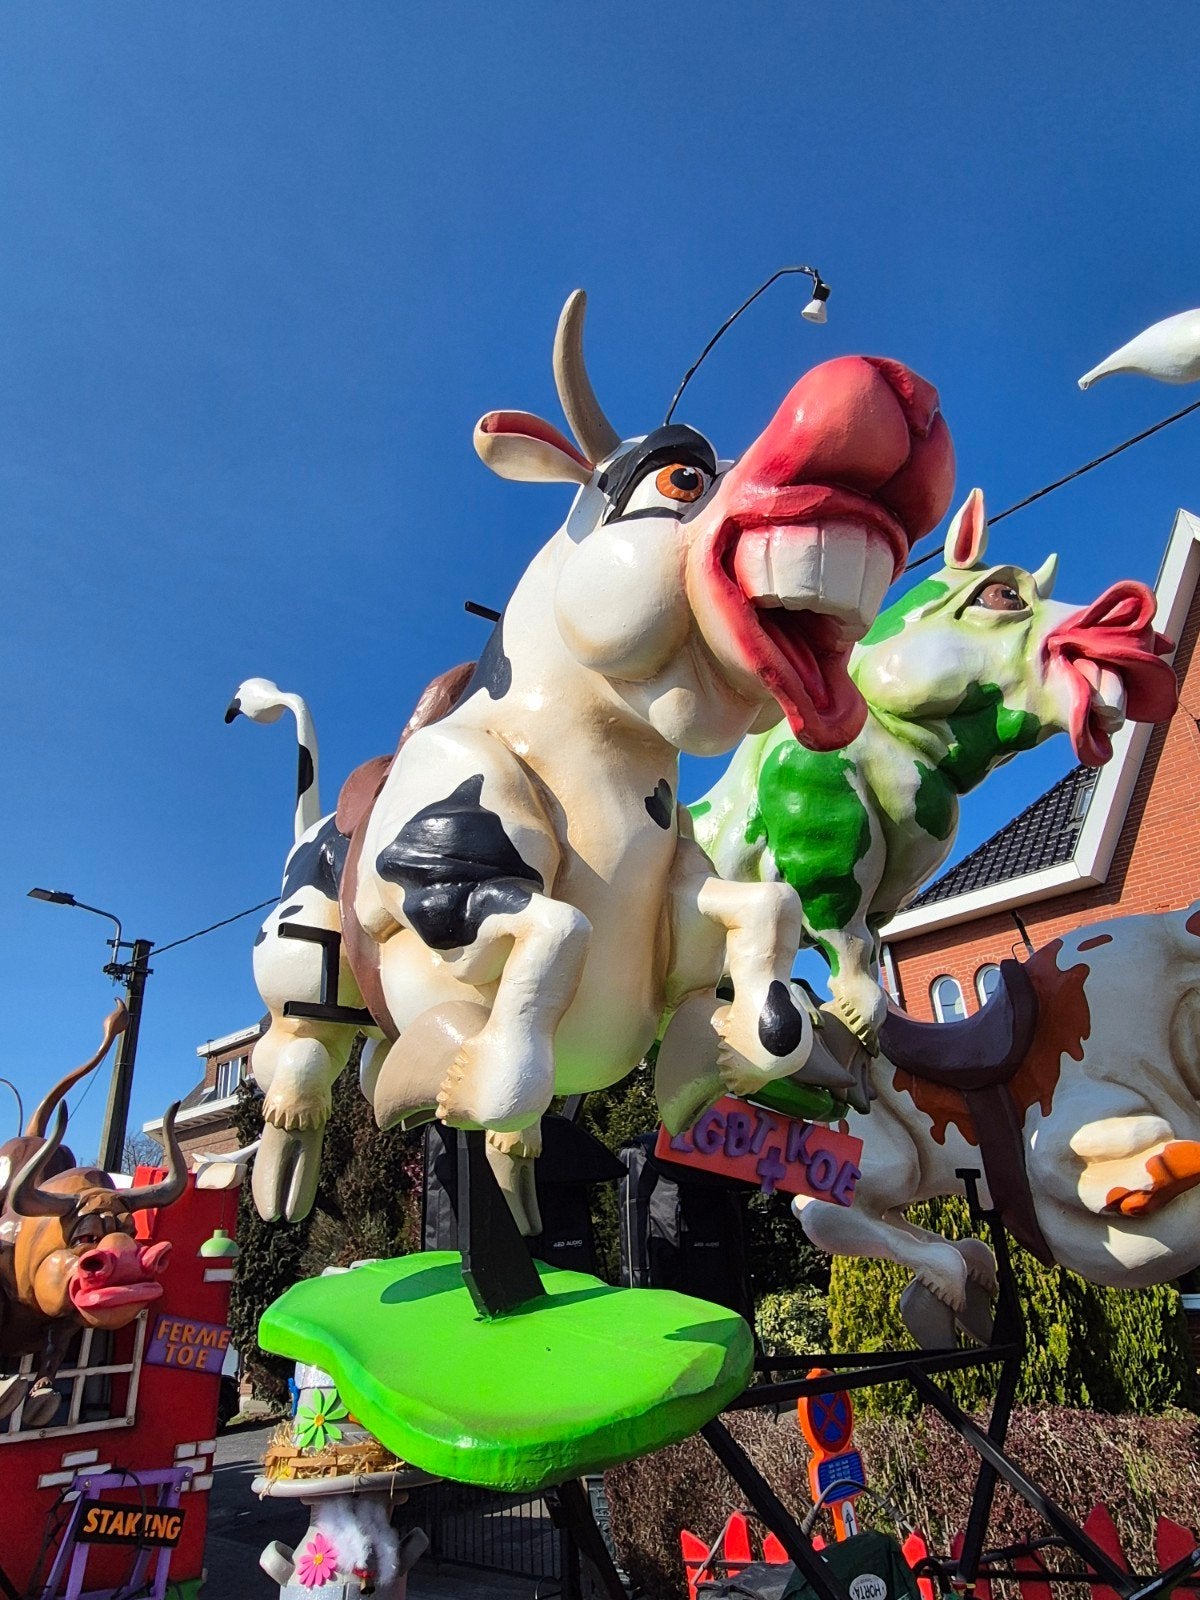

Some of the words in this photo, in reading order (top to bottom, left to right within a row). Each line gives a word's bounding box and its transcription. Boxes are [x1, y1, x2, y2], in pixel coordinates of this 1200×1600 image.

[566, 1239, 583, 1247] AUDIO
[157, 1319, 231, 1350] FERME
[165, 1343, 209, 1369] TOE
[83, 1507, 181, 1540] STAKING
[852, 1583, 882, 1600] HORTA
